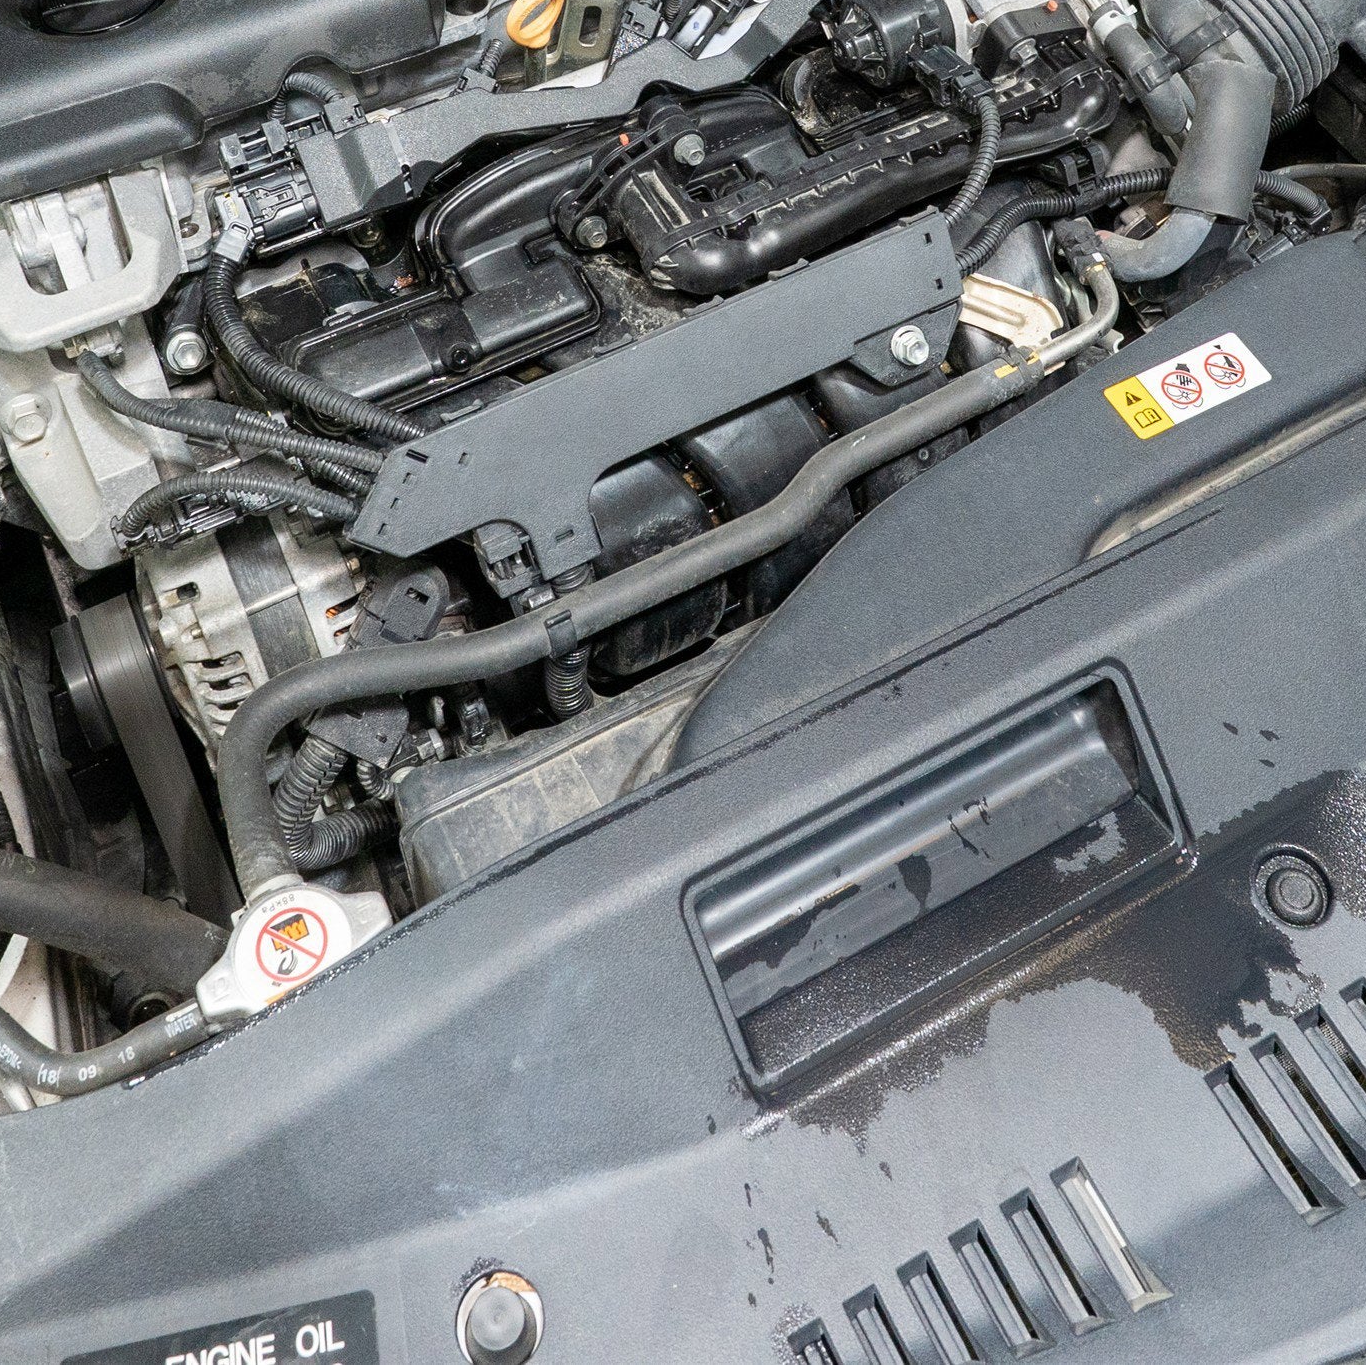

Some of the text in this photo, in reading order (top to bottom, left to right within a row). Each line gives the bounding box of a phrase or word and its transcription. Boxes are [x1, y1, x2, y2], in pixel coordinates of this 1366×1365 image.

[78, 1064, 97, 1082] 09
[117, 1046, 136, 1064] 18
[164, 1012, 198, 1038] WATER
[295, 1319, 346, 1358] OIL
